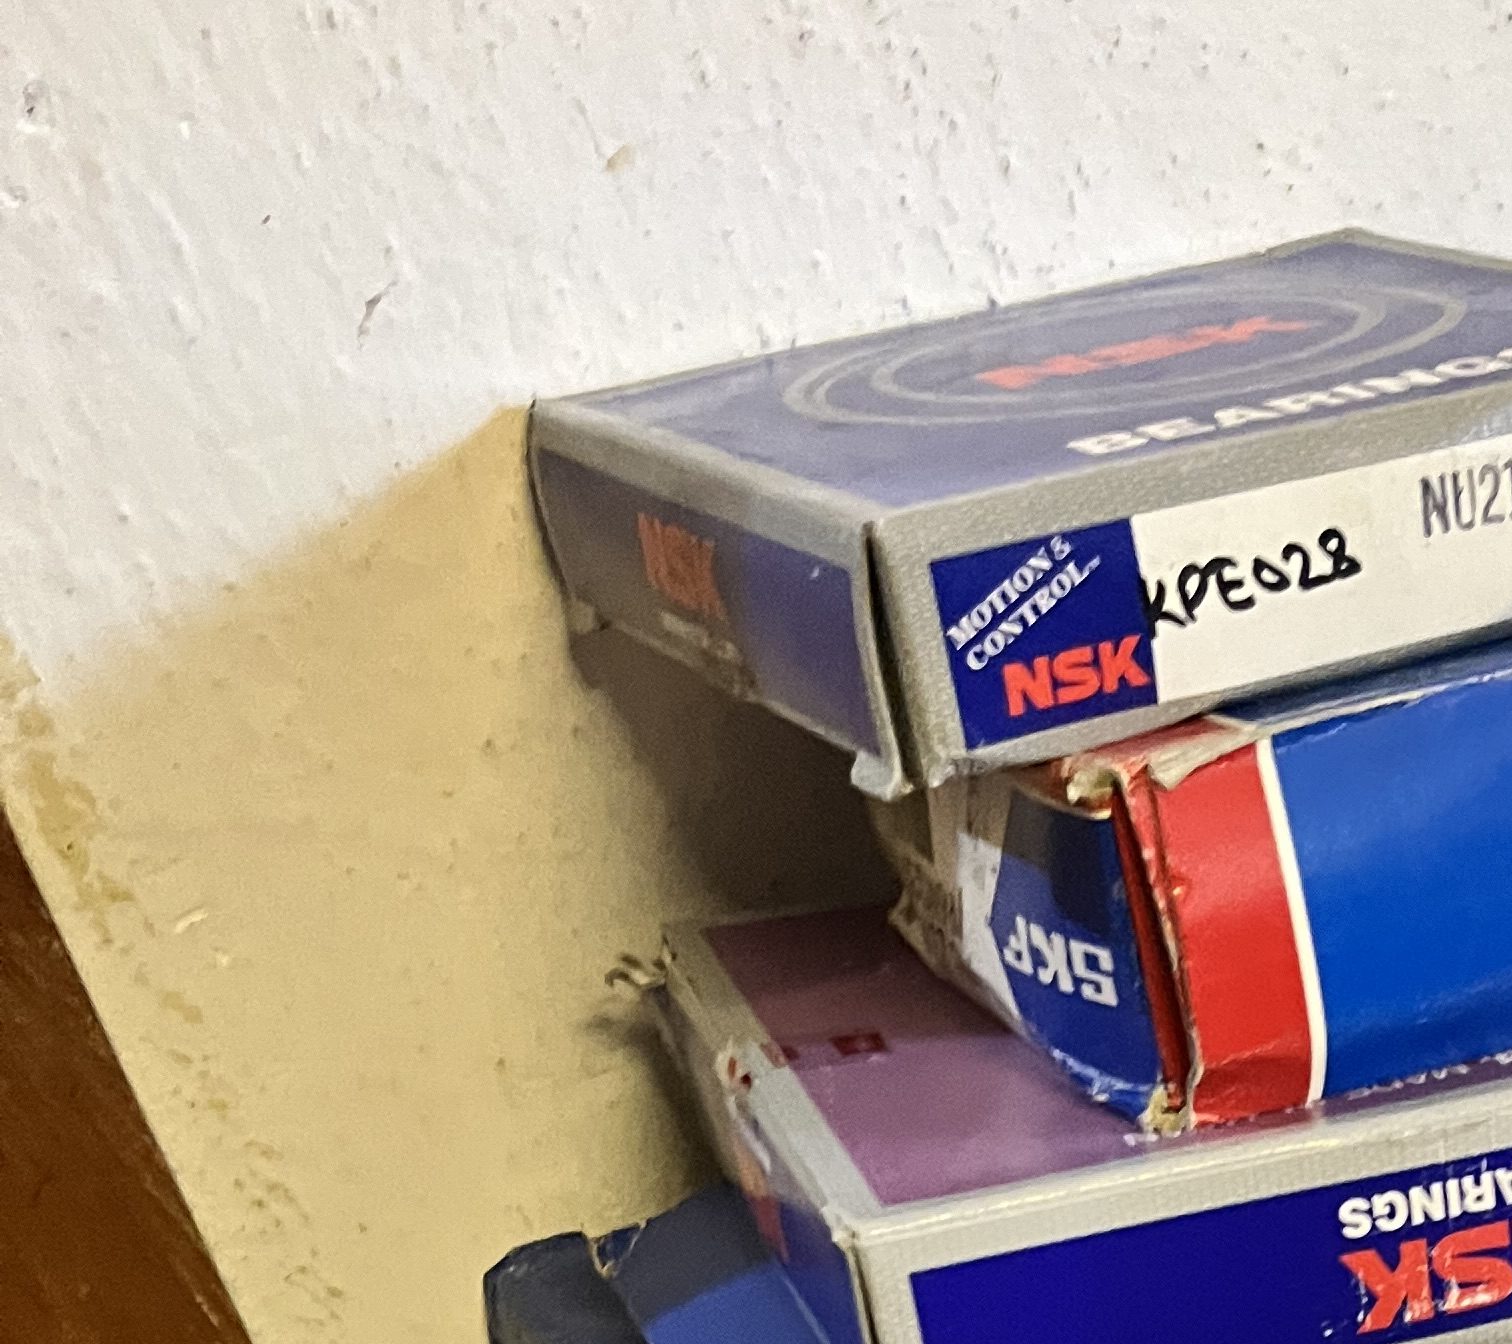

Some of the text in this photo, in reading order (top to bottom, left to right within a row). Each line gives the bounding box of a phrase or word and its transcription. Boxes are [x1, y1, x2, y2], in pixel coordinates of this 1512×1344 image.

[946, 547, 1053, 651] MOTION
[1002, 633, 1150, 717] NSK
[1003, 914, 1119, 1008] SKF
